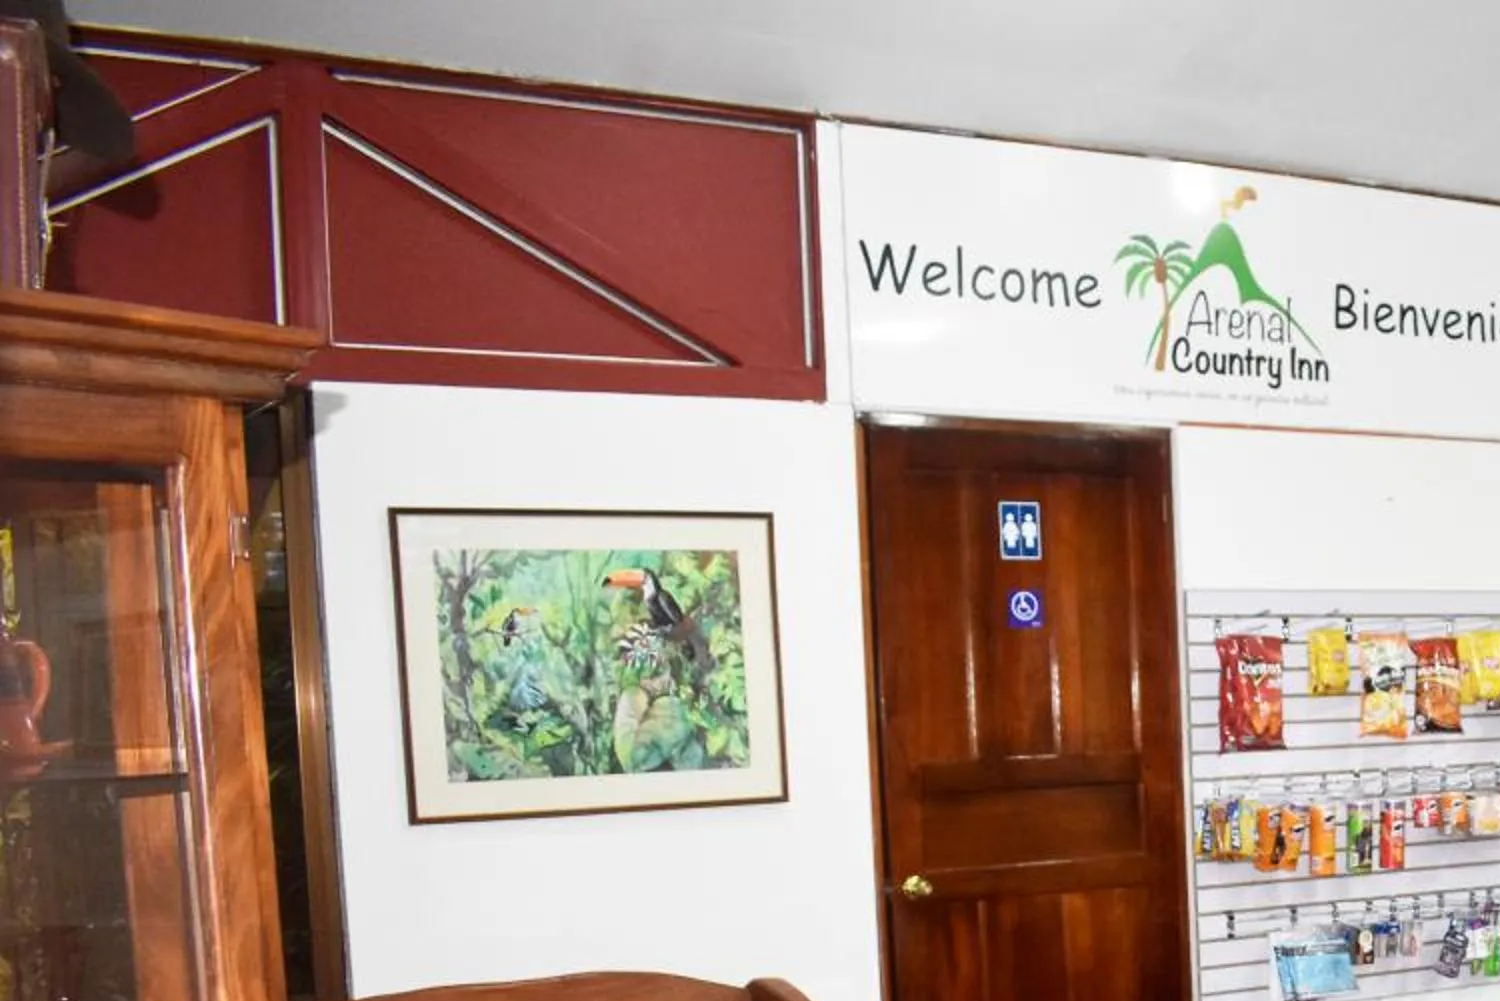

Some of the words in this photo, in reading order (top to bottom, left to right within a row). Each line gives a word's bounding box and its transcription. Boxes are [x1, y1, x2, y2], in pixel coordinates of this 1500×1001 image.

[859, 239, 1102, 309] Welcome
[1185, 290, 1292, 345] Arenal
[1171, 337, 1282, 389] Country
[1290, 346, 1330, 382] Inn
